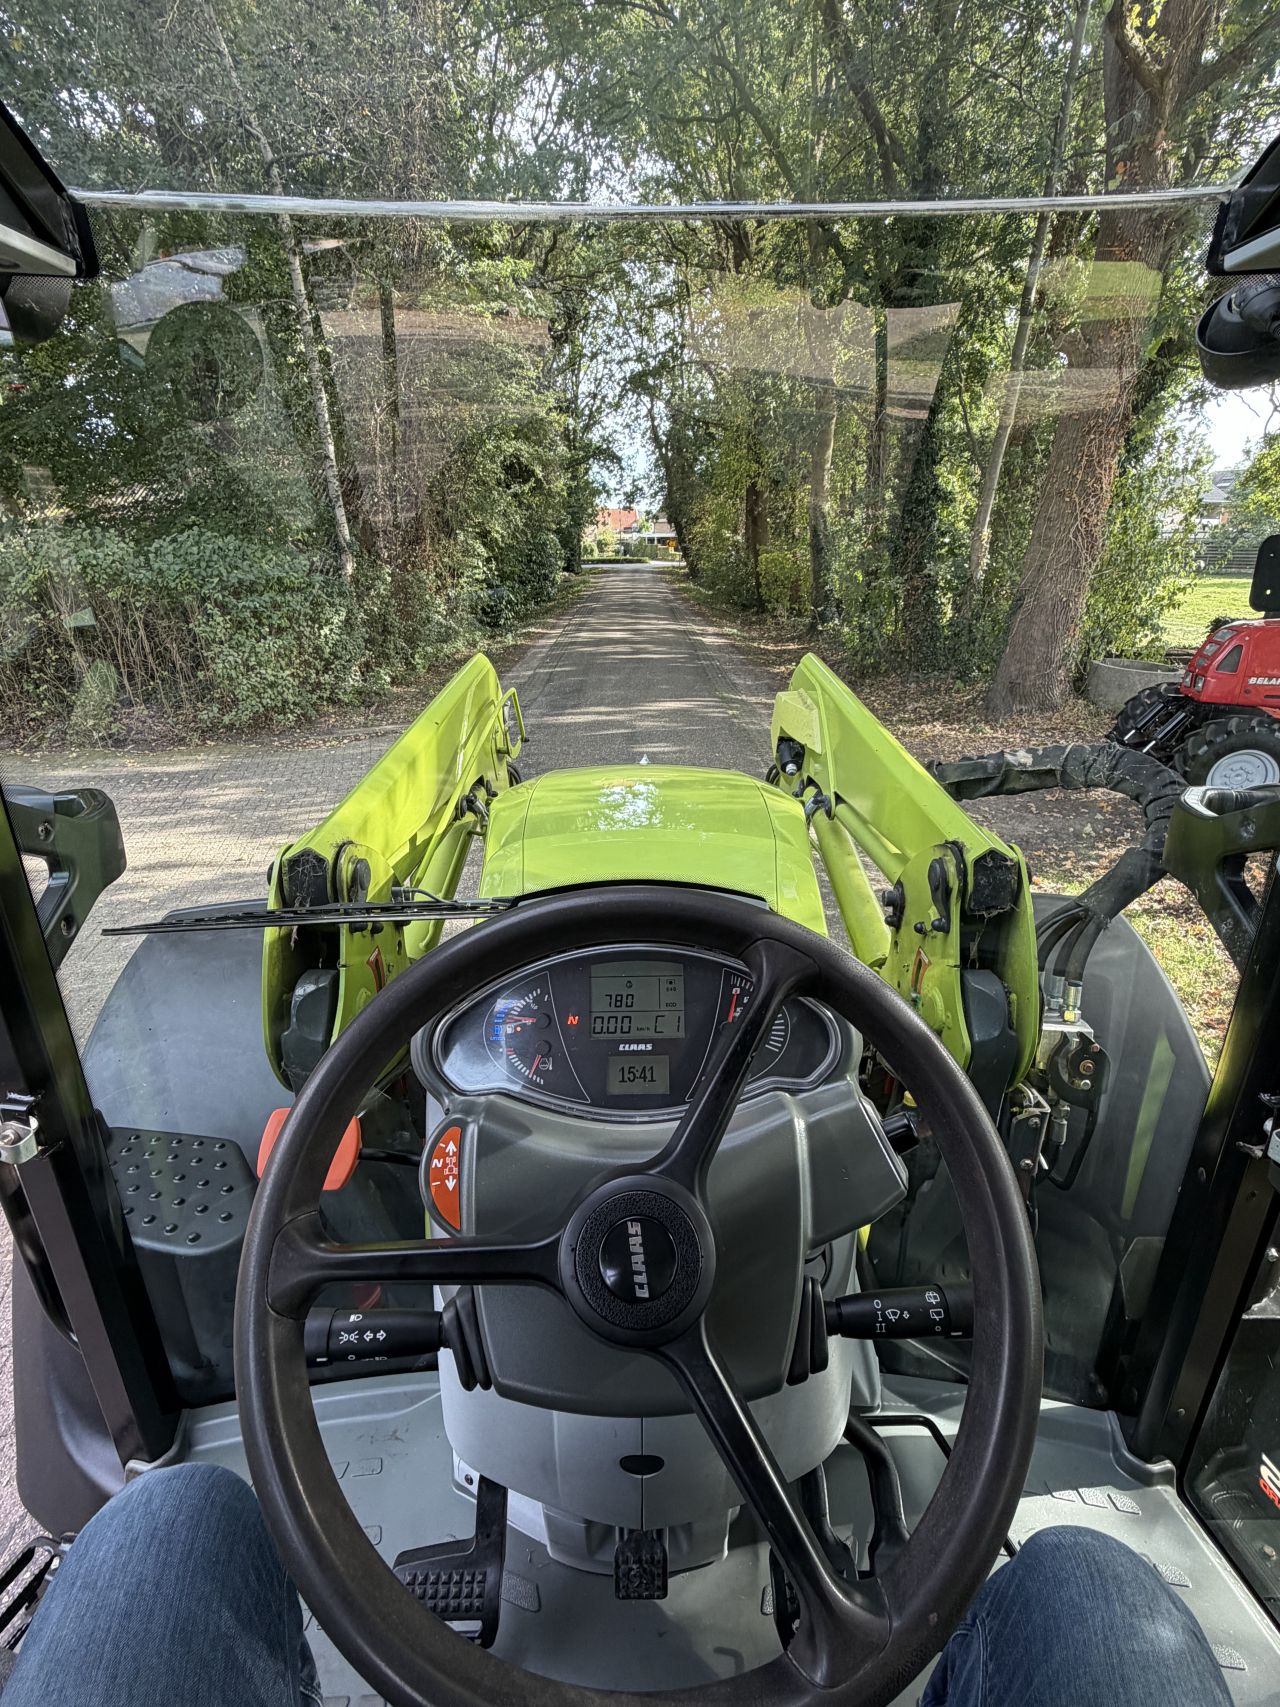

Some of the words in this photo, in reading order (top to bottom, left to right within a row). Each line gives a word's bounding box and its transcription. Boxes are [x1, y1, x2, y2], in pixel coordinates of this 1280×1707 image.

[604, 993, 635, 1008] 780
[567, 1014, 579, 1026] N
[592, 1015, 632, 1035] 0.00
[618, 1043, 653, 1051] CLAAS
[618, 1065, 657, 1083] 15:41
[431, 1158, 444, 1168] N
[626, 1221, 650, 1299] CLAAS
